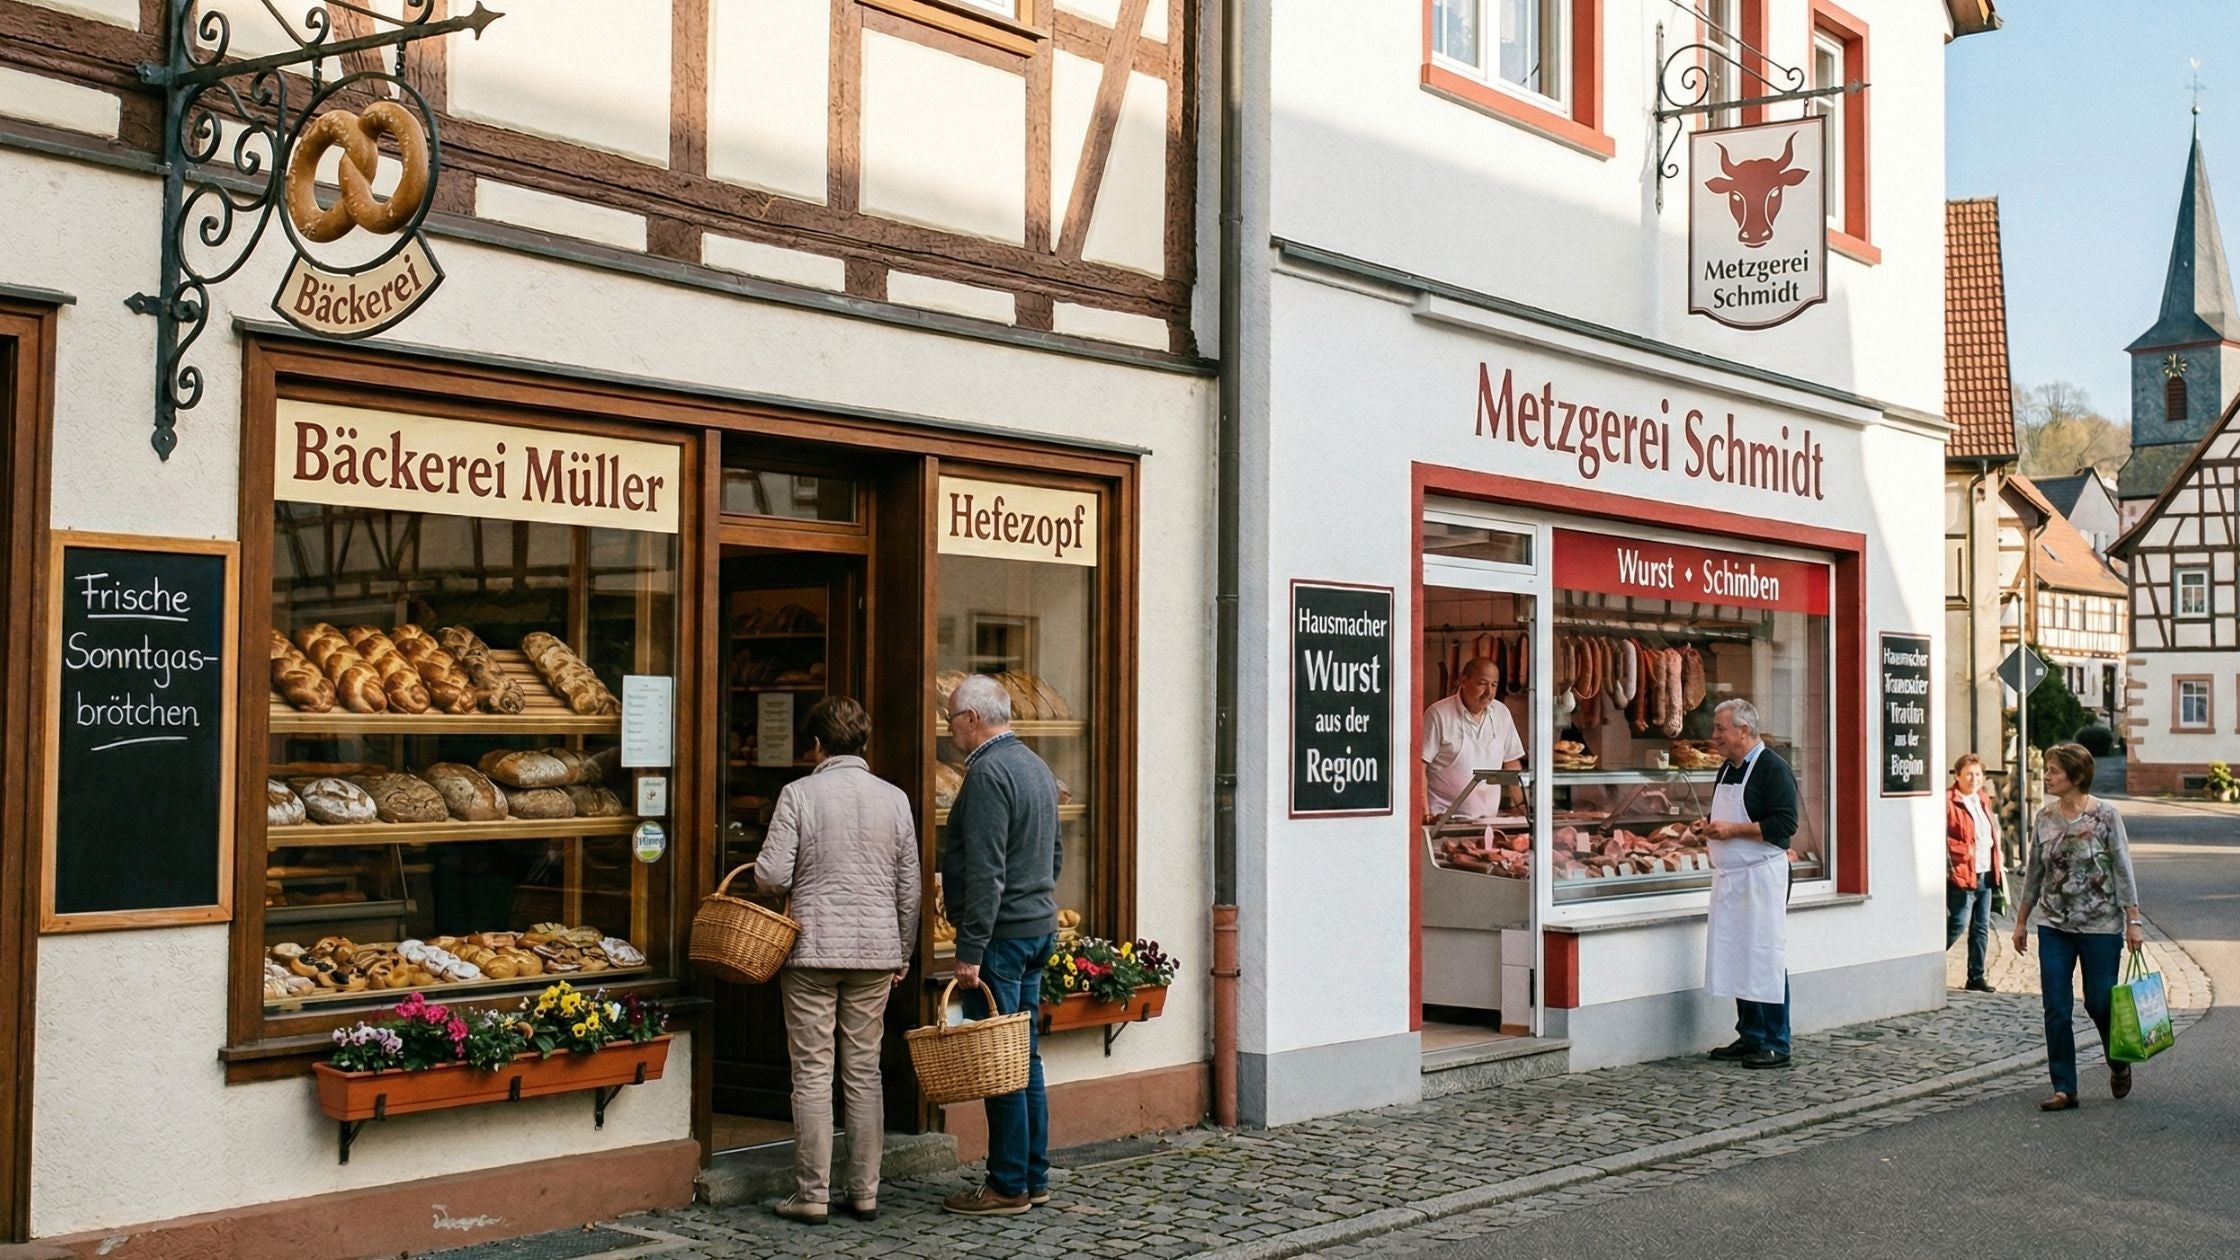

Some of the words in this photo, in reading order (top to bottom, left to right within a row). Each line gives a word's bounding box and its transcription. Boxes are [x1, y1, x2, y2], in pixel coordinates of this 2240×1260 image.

[1704, 249, 1809, 283] Metzgerei
[293, 253, 423, 325] Bäckerei
[1713, 280, 1801, 309] Schmidt
[1475, 361, 1670, 480] Metzgerei
[1684, 408, 1824, 501] Schmidt
[292, 421, 507, 499] Bäckerei
[521, 446, 664, 513] Müller
[949, 492, 1086, 558] Hefezopf
[1616, 547, 1675, 590] Wurst
[74, 573, 191, 613] Frische
[1298, 607, 1388, 638] Hausmacher
[65, 631, 219, 689] Sonntgas-
[1303, 649, 1381, 694] Wurst
[76, 690, 201, 727] brötchen
[1315, 711, 1342, 733] aus
[1345, 706, 1370, 733] der
[1306, 745, 1378, 794] Region
